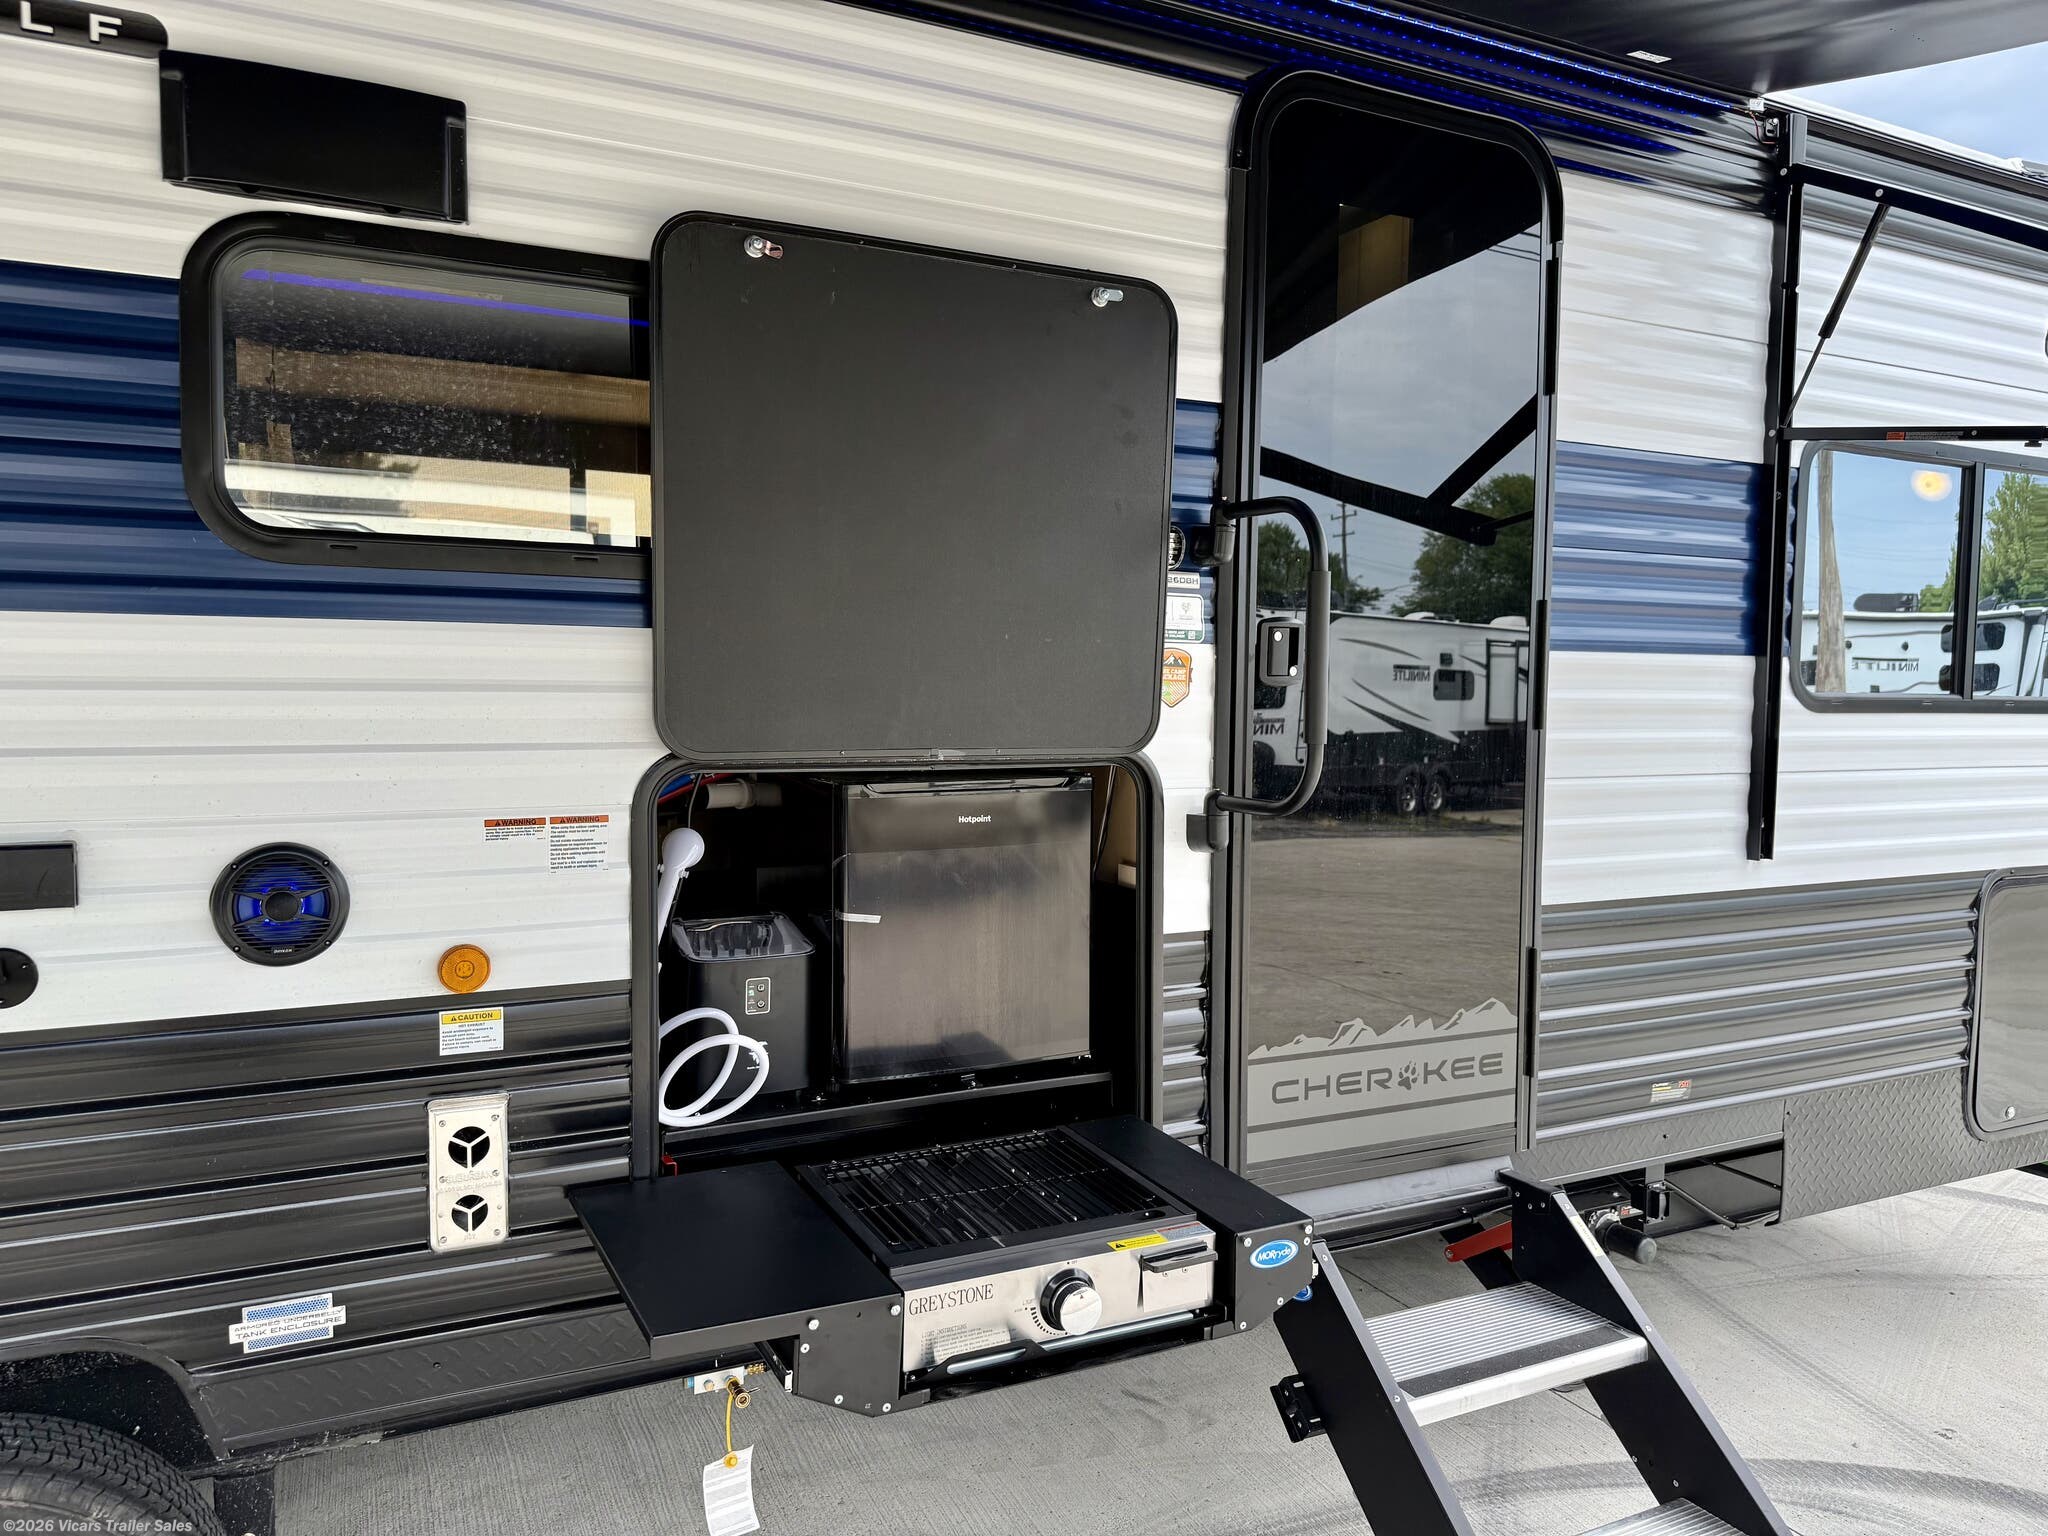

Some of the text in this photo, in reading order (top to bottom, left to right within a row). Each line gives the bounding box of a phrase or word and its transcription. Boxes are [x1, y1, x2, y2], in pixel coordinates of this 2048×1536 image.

[501, 817, 537, 826] WARNING
[566, 815, 600, 824] WARNING
[958, 814, 992, 824] Hotpoint
[457, 1012, 493, 1021] CAUTION
[908, 1283, 994, 1316] GREYSTONE
[234, 1307, 345, 1332] ARMORED UNDERBELLY
[235, 1315, 342, 1340] TANK ENCLOSURE
